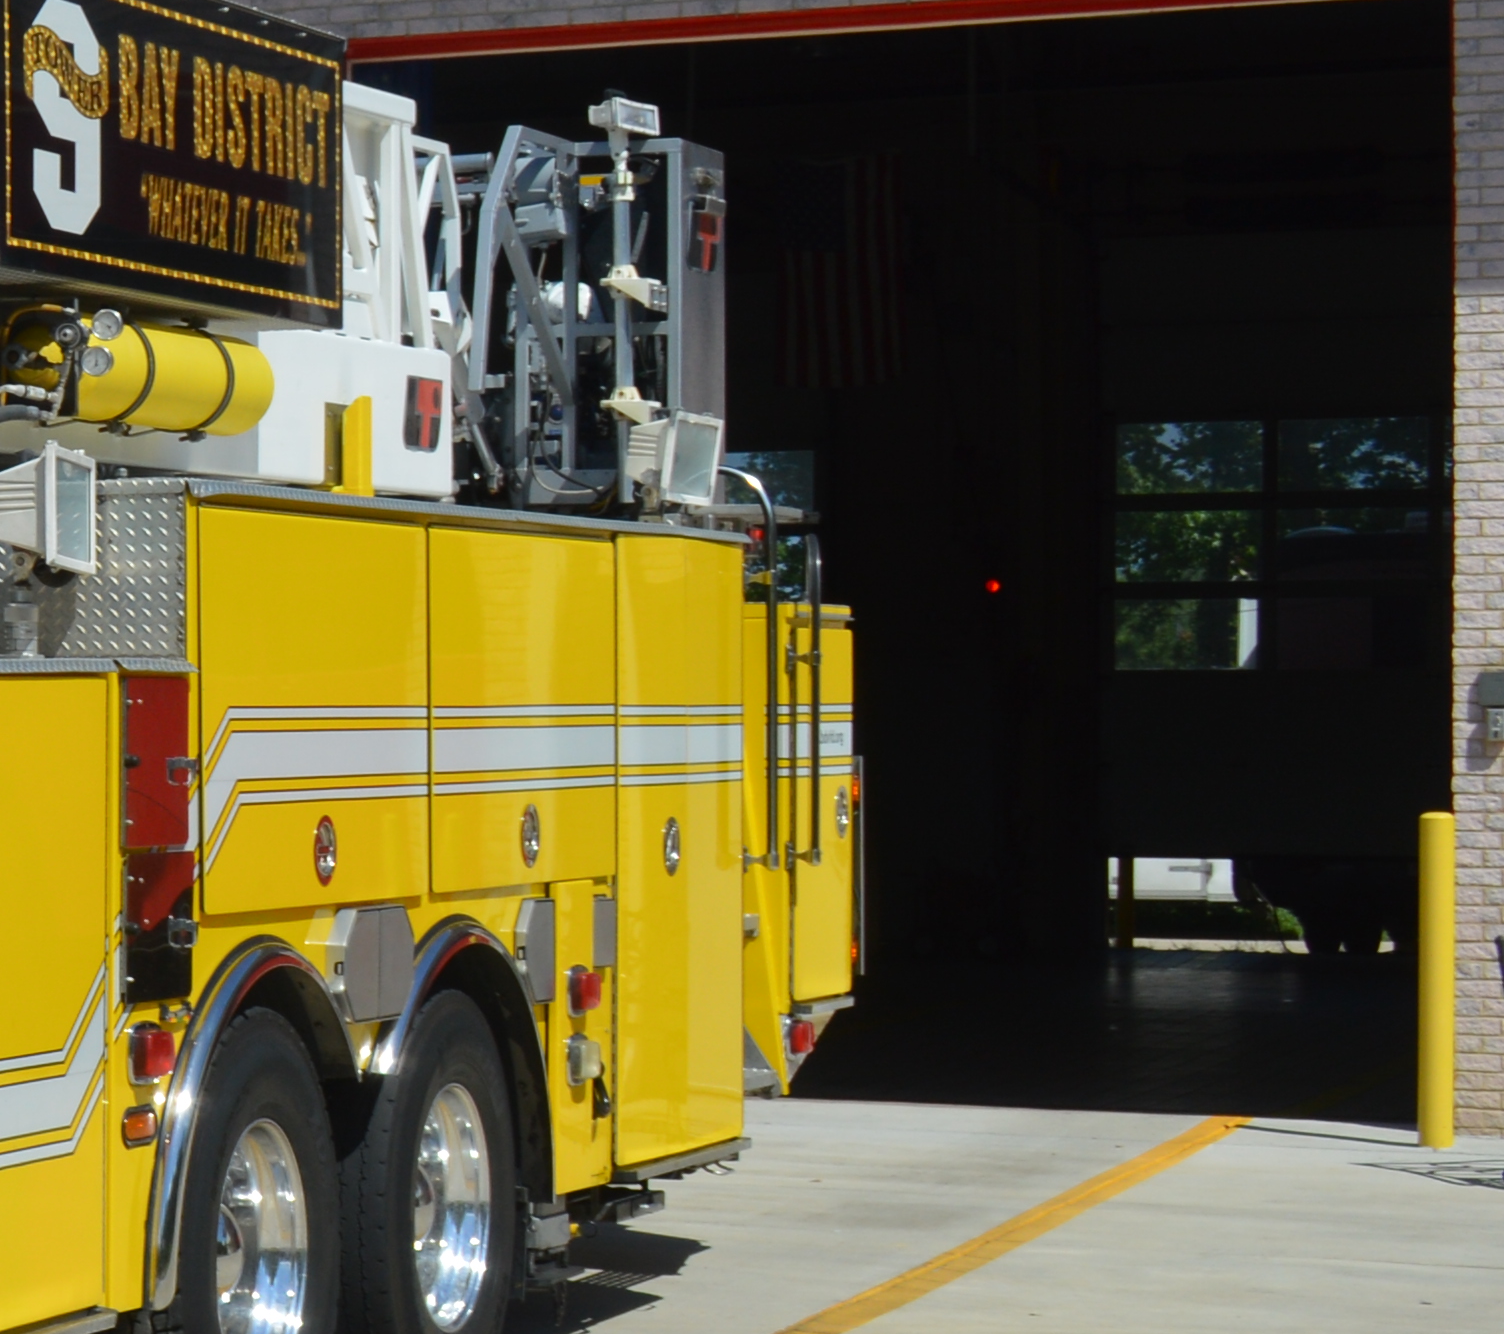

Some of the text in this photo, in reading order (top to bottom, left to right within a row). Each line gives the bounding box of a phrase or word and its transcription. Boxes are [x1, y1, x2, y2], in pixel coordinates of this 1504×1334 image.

[32, 28, 103, 113] TOWER
[117, 33, 331, 189] BAY DISTRICT
[233, 196, 252, 256] IT
